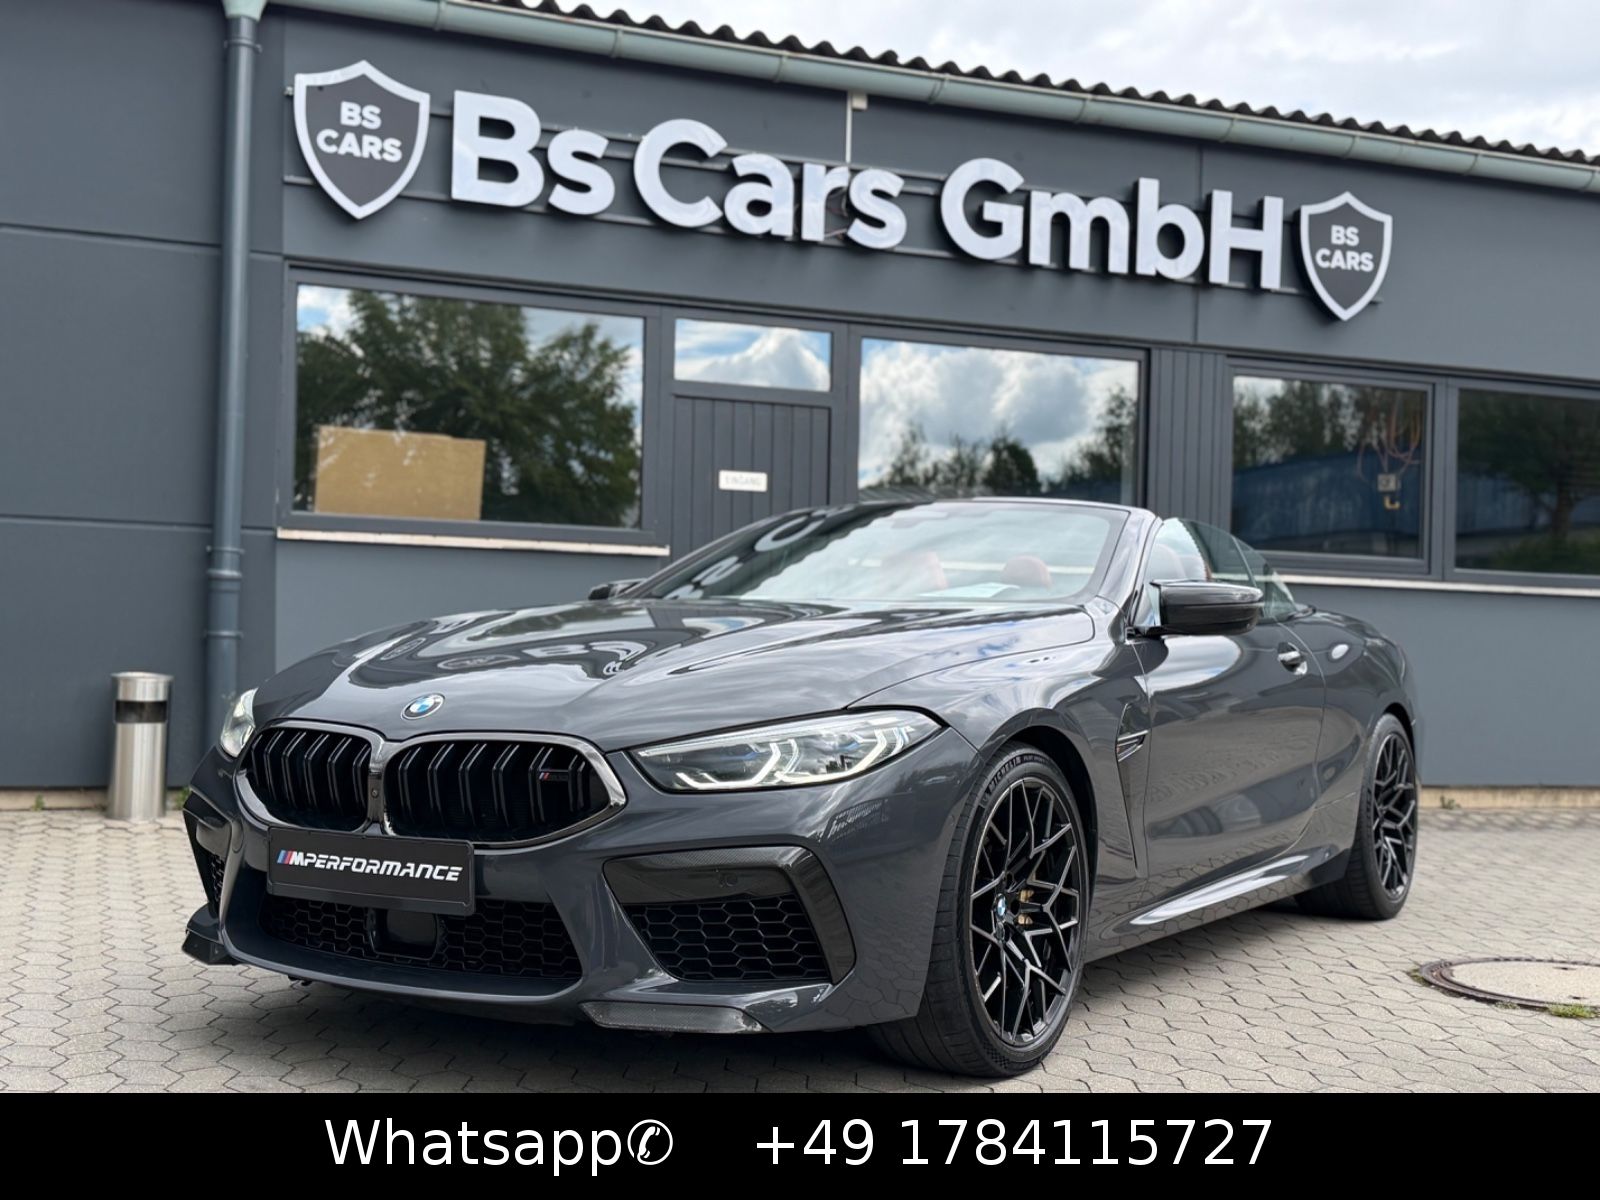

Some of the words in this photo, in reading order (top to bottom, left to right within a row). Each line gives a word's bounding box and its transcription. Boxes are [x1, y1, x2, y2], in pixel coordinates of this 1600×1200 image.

[340, 101, 382, 130] BS
[316, 128, 403, 163] CARS
[940, 157, 1284, 290] GmbH
[1331, 224, 1360, 247] BS
[1315, 247, 1375, 273] CARS
